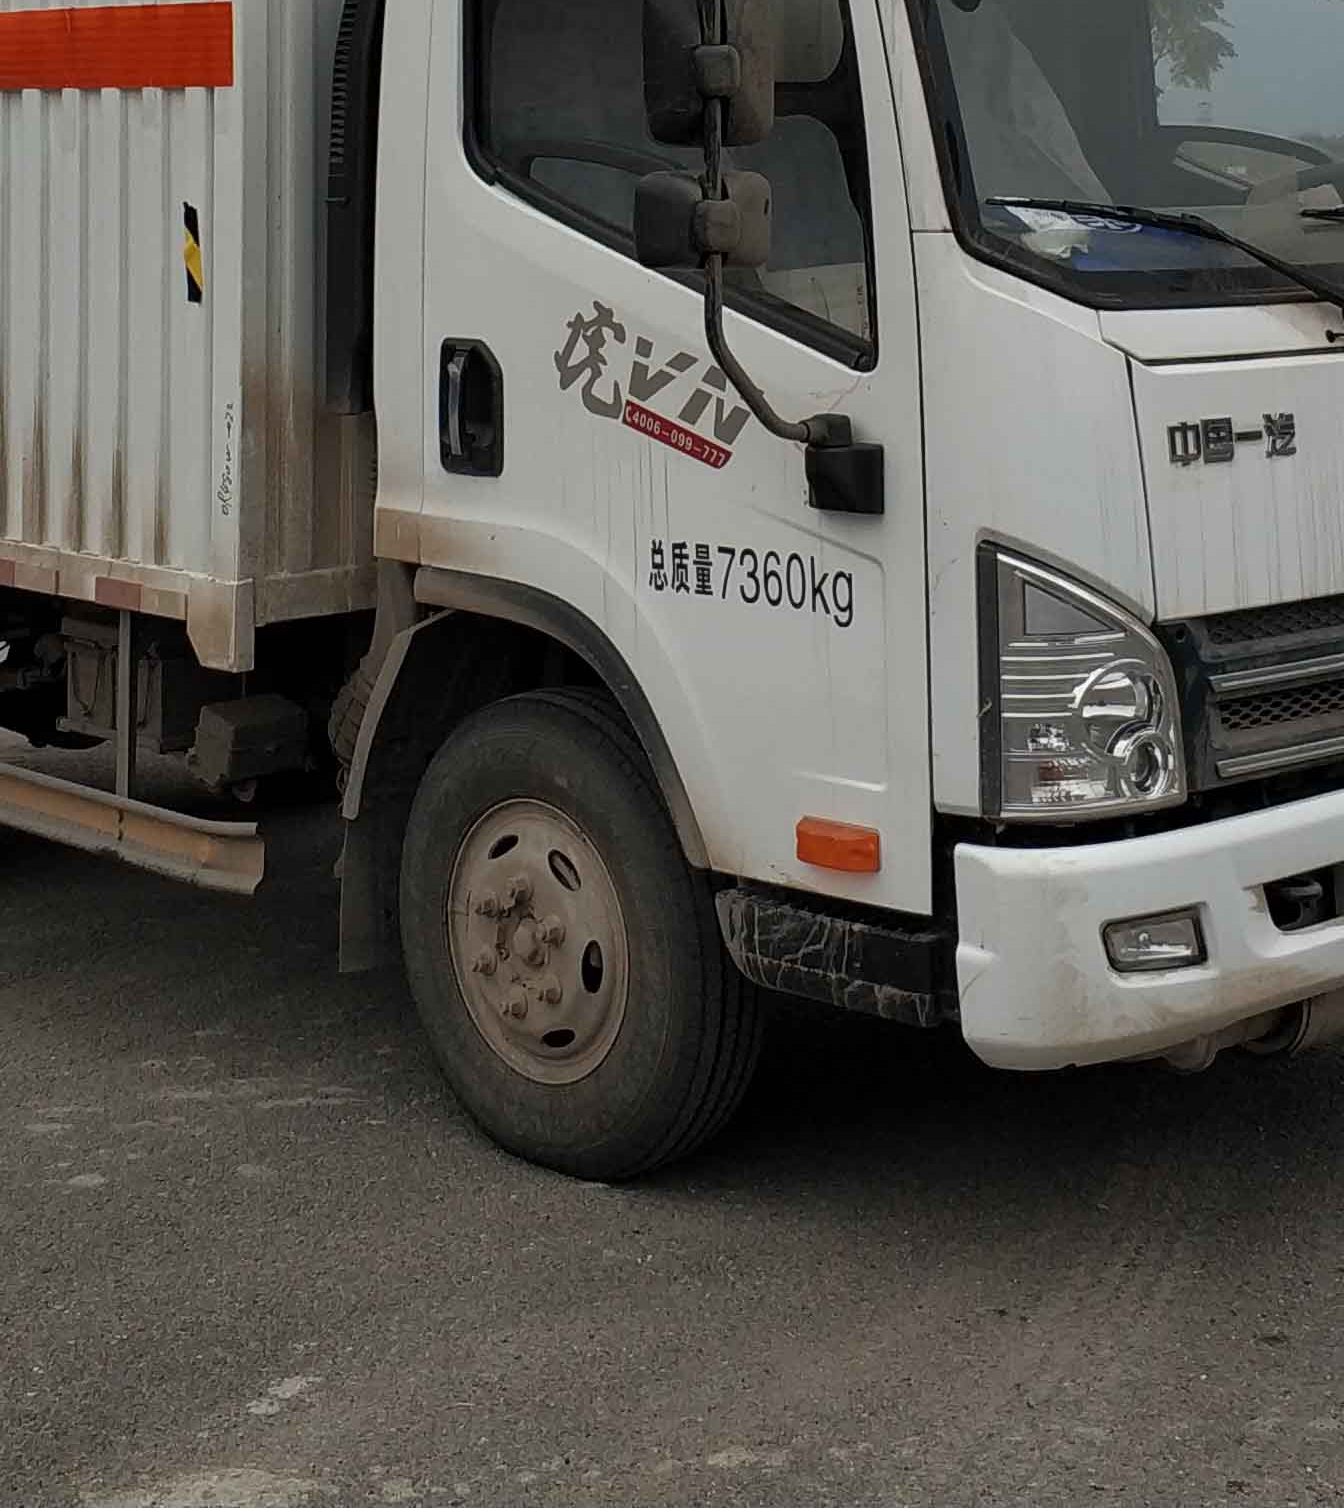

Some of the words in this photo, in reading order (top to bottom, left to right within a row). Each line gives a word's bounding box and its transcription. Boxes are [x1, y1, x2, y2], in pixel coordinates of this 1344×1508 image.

[631, 411, 726, 468] 4006-099-777
[1167, 412, 1298, 467] 中国一汽
[649, 539, 853, 628] 总质量7360kg
